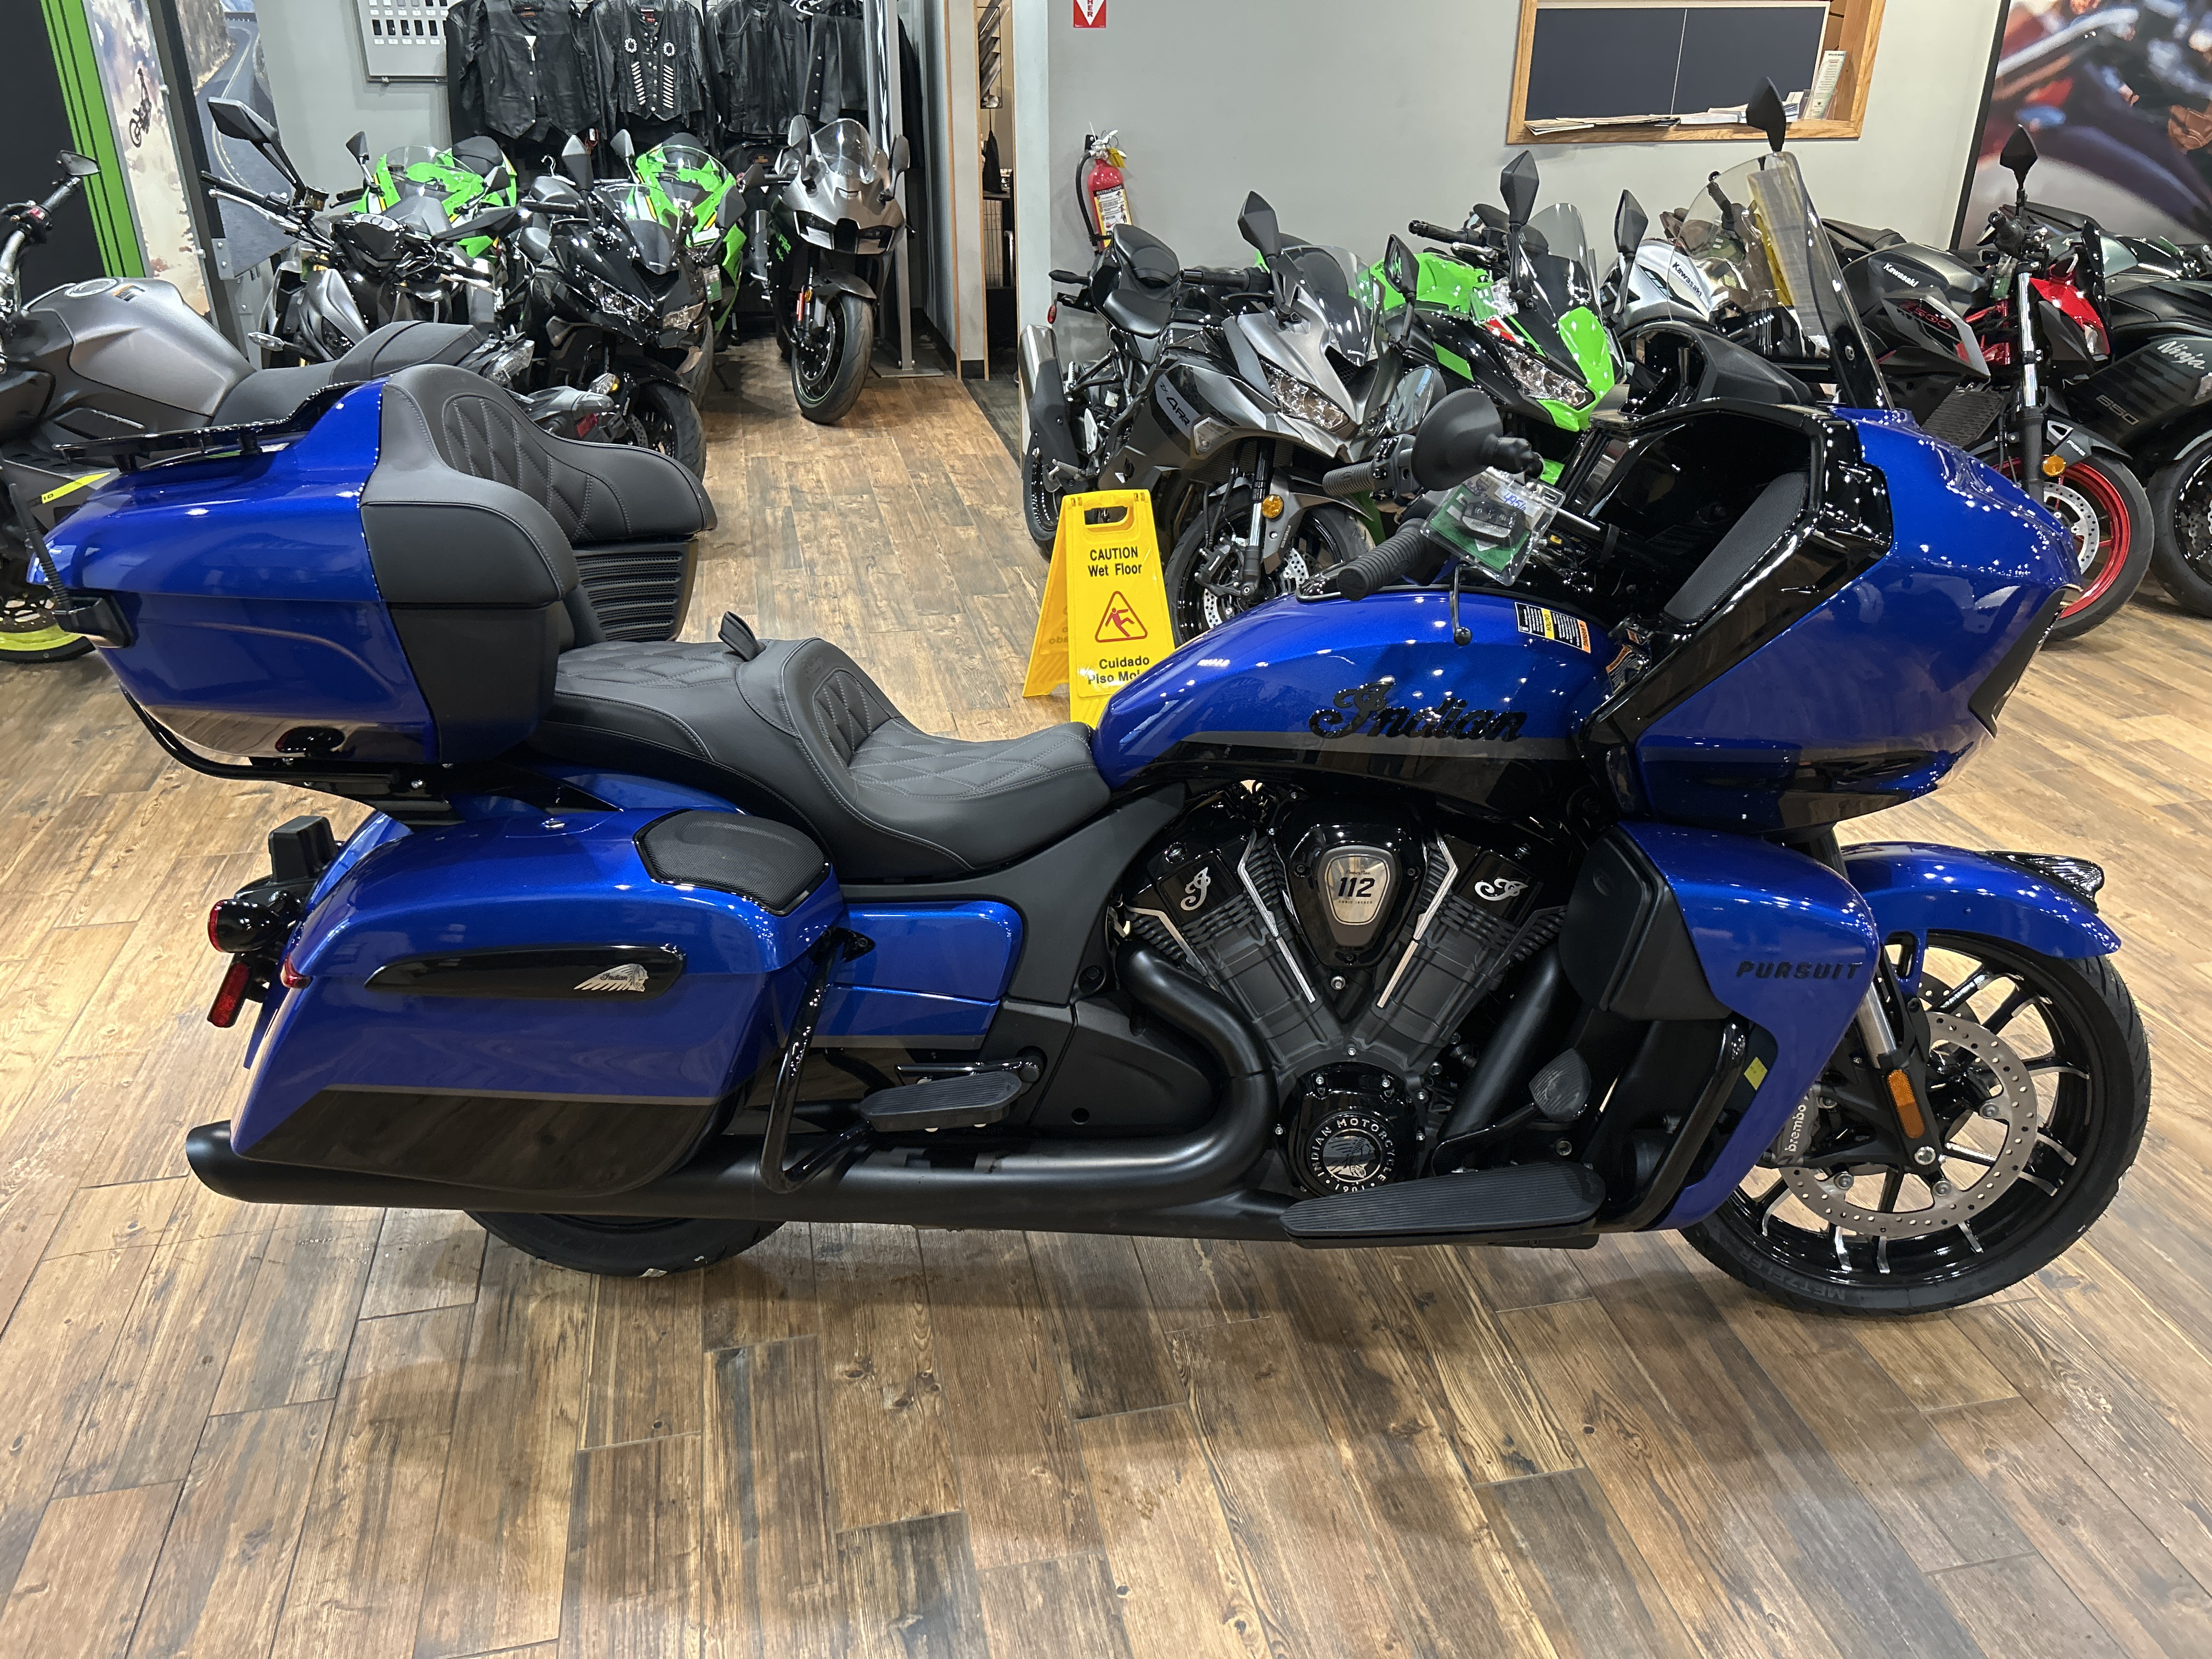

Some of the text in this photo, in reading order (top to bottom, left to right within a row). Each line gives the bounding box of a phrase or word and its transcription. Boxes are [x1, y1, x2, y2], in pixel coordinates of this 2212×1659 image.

[1672, 261, 1702, 297] Kawasaki
[1883, 263, 1920, 287] Kawasaki
[2157, 341, 2206, 370] Ninja
[2095, 394, 2140, 426] 650
[1090, 546, 1138, 561] CAUTION
[1087, 562, 1142, 577] Wet Floor
[1099, 655, 1150, 669] Cuidado
[1309, 679, 1528, 742] Indian
[1338, 877, 1375, 898] 112
[600, 973, 628, 981] Indian
[1736, 961, 1863, 979] PURSUIT
[1784, 1103, 1807, 1153] brembo
[1311, 1118, 1396, 1182] INDIAN MOTORCYCLE
